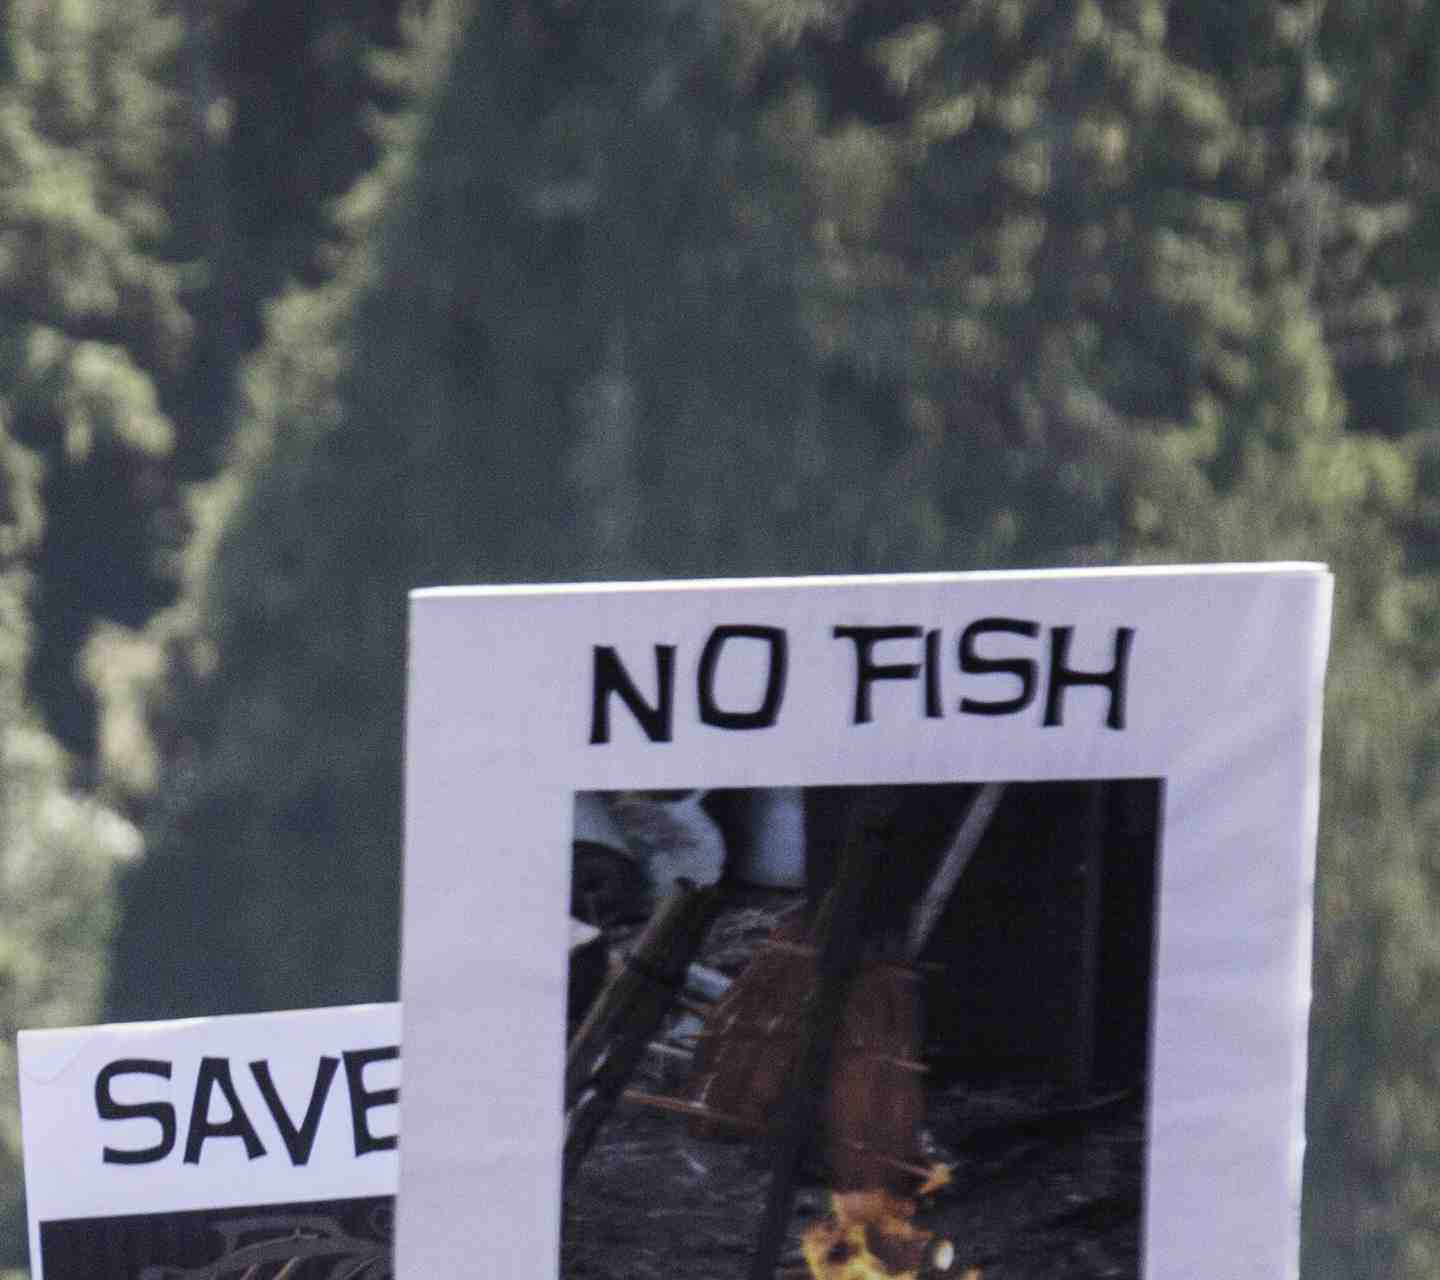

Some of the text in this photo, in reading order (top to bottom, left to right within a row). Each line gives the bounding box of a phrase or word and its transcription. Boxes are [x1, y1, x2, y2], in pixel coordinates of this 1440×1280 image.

[588, 617, 1136, 746] NO FISH
[94, 1045, 400, 1167] SAVE
